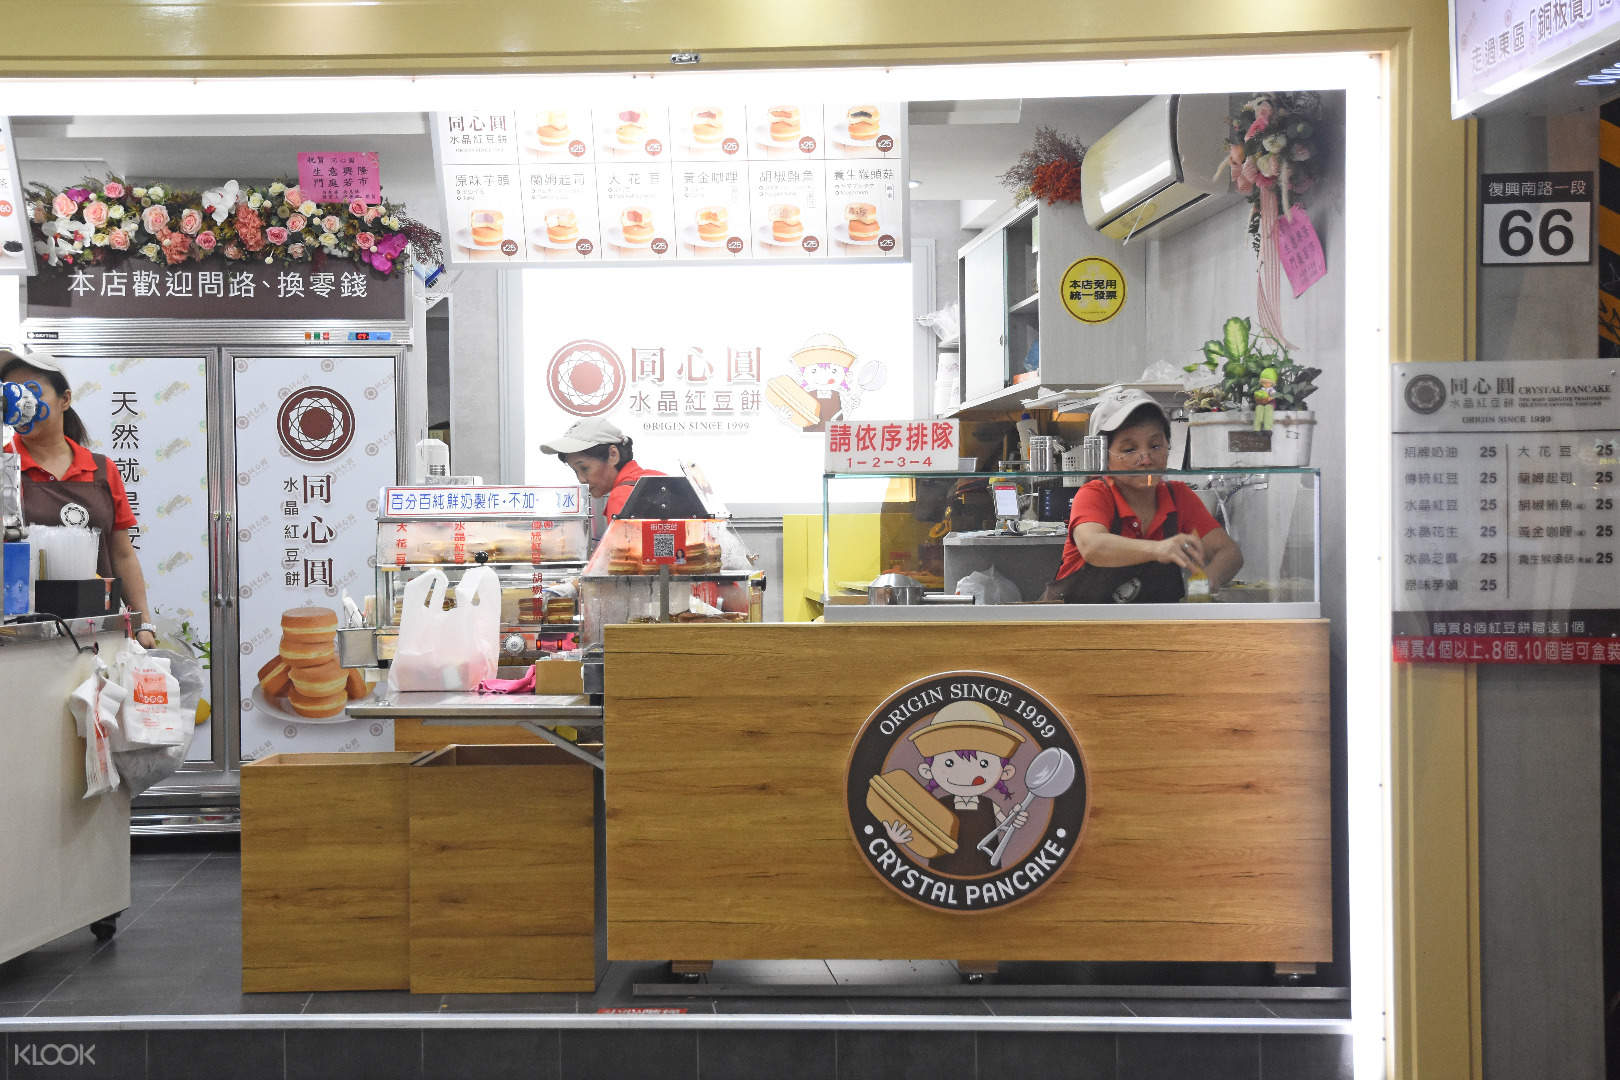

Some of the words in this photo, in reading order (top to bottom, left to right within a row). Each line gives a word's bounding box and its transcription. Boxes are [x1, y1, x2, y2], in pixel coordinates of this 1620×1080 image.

[449, 115, 506, 132] 同心圓
[313, 167, 368, 177] 生意興隆
[313, 177, 368, 188] 門庭若市
[1489, 180, 1586, 196] 復興南路一段
[1499, 208, 1574, 257] 66
[67, 270, 368, 299] 本店歡迎問路、換零錢
[1069, 280, 1117, 290] 本店免用
[1069, 290, 1117, 300] 統一發票
[631, 346, 762, 383] 同心圓
[1450, 377, 1515, 395] 同心圓
[1518, 386, 1562, 395] CRYSTAL
[1564, 384, 1611, 394] PANCAKE
[630, 389, 761, 413] 水晶紅豆餅
[1462, 415, 1495, 424] ORIGIN
[1498, 415, 1526, 424] SINCE
[1530, 415, 1552, 424] 1999
[643, 421, 686, 431] ORIGIN
[689, 421, 724, 431] SINCE
[726, 421, 750, 430] 1999
[830, 421, 953, 453] 請依序排隊
[1480, 446, 1497, 458] 25
[1518, 446, 1572, 457] 大花豆
[1595, 444, 1613, 456] 25
[1480, 472, 1497, 484] 25
[1595, 472, 1613, 483] 25
[1404, 499, 1458, 511] 水晶紅豆
[1480, 499, 1497, 510] 25
[1595, 499, 1613, 510] 25
[283, 476, 300, 587] 水晶紅豆餅
[302, 474, 335, 588] 同心圓
[1404, 526, 1458, 538] 水晶花生
[1480, 526, 1497, 537] 25
[1595, 526, 1613, 537] 25
[396, 522, 407, 567] 大花豆
[454, 520, 465, 564] 水晶紅豆
[1480, 553, 1497, 564] 25
[1595, 553, 1613, 564] 25
[1480, 579, 1497, 591] 25
[879, 687, 943, 735] ORIGIN
[950, 683, 1012, 706] SINCE
[1014, 699, 1056, 738] 1999
[868, 838, 957, 905] CRYSTAL
[966, 840, 1065, 905] PANCAKE
